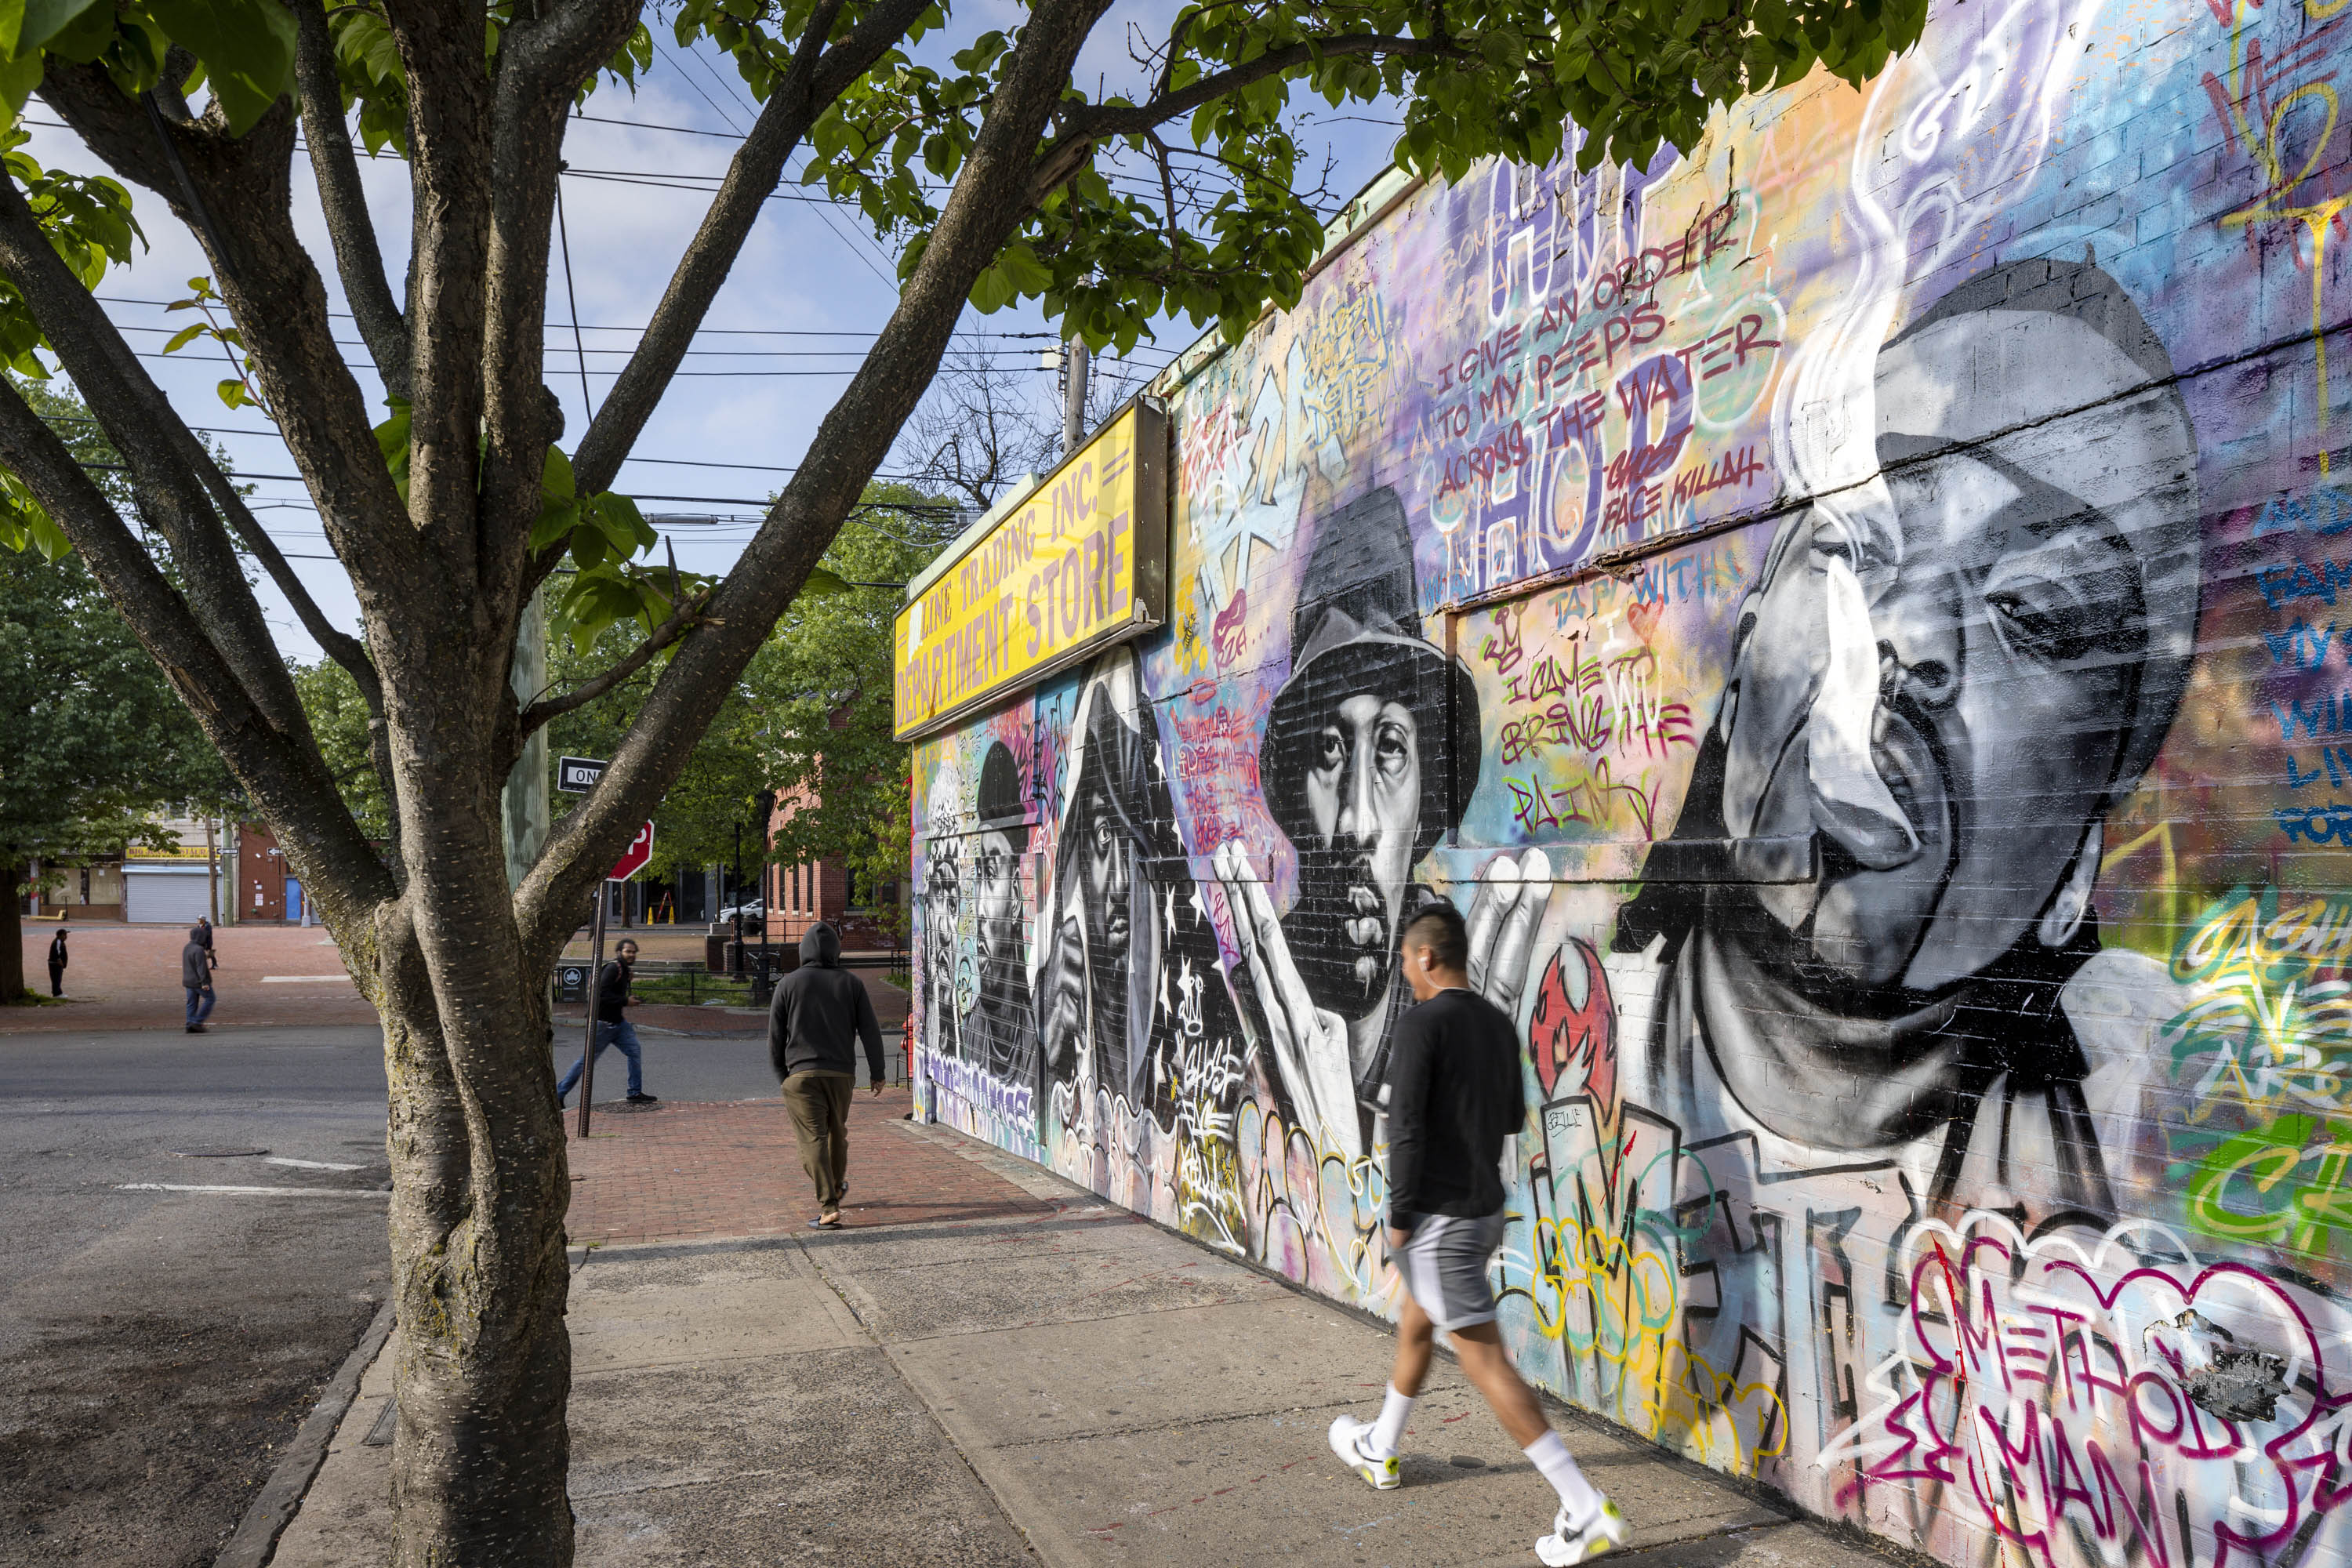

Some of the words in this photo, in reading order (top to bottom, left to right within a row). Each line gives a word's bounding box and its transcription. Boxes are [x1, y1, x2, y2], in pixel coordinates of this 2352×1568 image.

[1438, 364, 1454, 394] I
[1458, 325, 1522, 383] GIVE
[1535, 289, 1578, 342] AN
[1593, 204, 1740, 311] ORDER
[1436, 402, 1471, 439] TO
[1479, 368, 1523, 419] MY
[1538, 300, 1666, 390] PEEPS
[1537, 391, 1607, 448] THE
[1617, 314, 1781, 421] WATER
[960, 508, 1036, 612] TRADING
[1050, 461, 1098, 543] INC.
[1600, 481, 1664, 535] FACE
[1670, 445, 1766, 510] KILLAH
[896, 592, 1013, 730] DEPARTMENT
[1025, 510, 1129, 659] STORE
[1505, 673, 1527, 705] I
[1529, 639, 1605, 702] CAME
[1501, 693, 1613, 766] BRING
[1605, 654, 1662, 733] WU
[575, 769, 597, 783] ON
[1977, 1397, 2172, 1568] MAN
